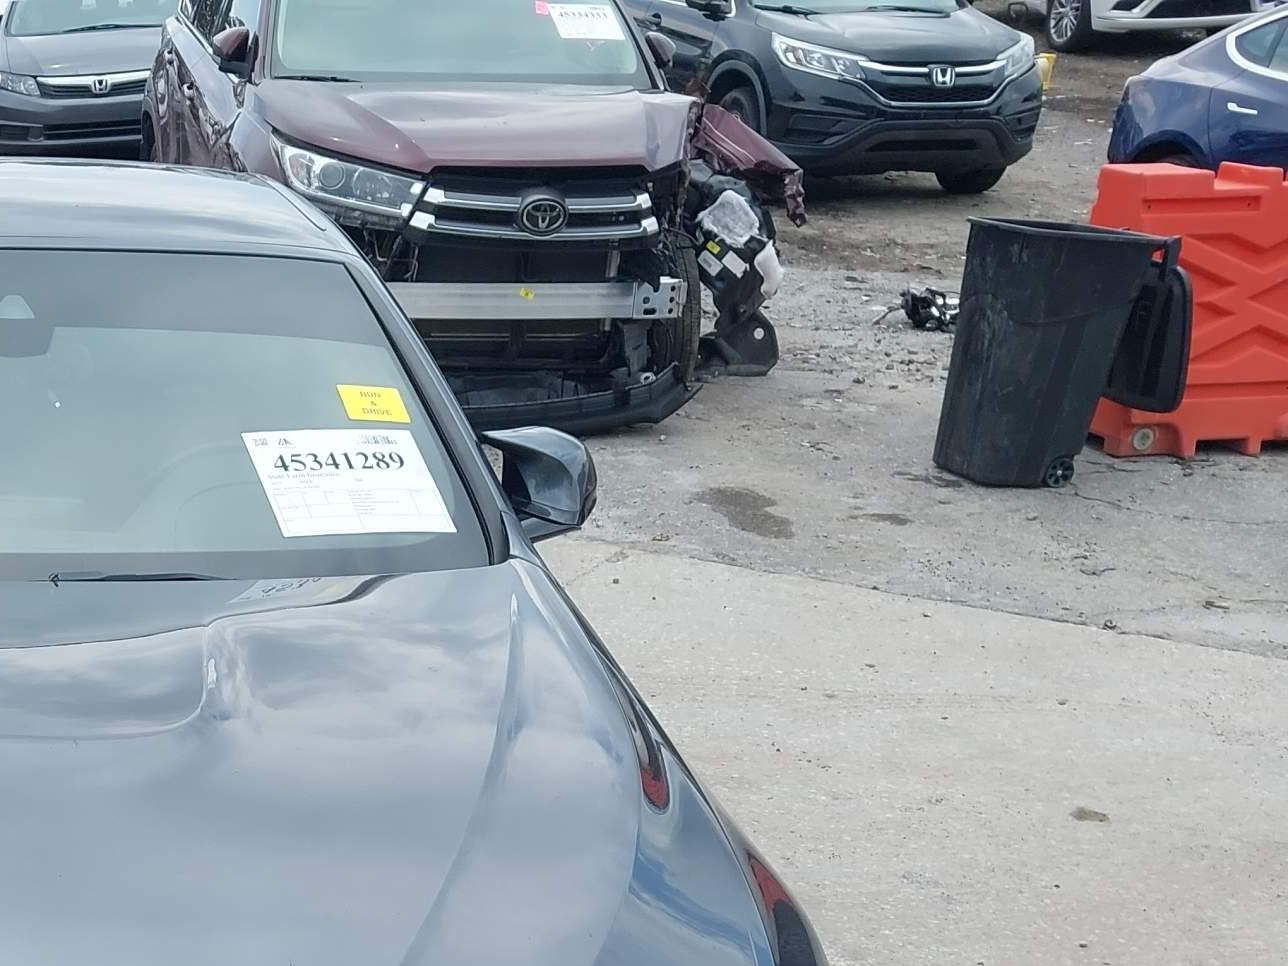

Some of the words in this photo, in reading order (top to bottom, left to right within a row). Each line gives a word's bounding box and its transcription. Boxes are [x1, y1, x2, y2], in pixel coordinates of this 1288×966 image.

[359, 390, 382, 399] RUN
[361, 407, 392, 417] DRIVE
[273, 451, 405, 472] 45341289
